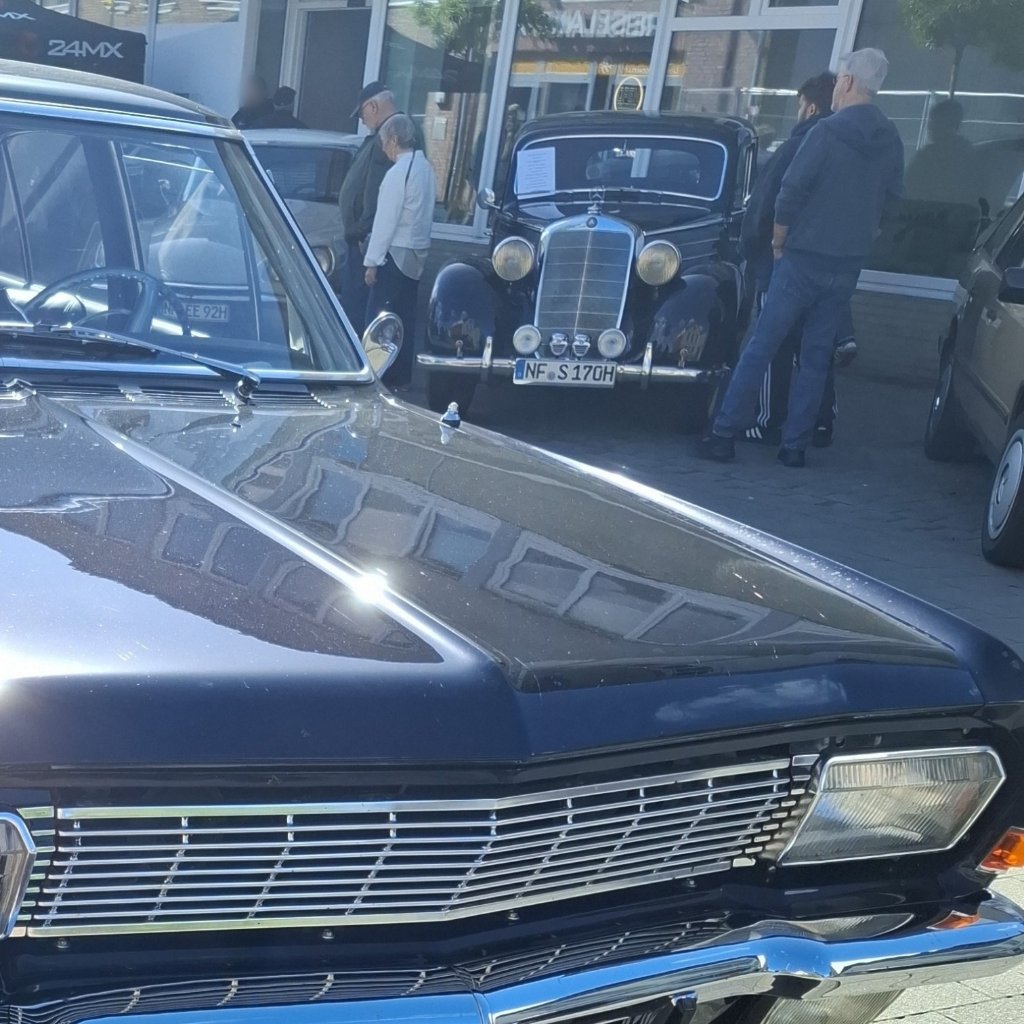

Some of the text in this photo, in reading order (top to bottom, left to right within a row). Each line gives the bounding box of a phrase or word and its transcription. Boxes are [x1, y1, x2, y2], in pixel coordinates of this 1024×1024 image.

[47, 39, 124, 58] 24MX
[203, 305, 227, 319] 92H
[525, 362, 615, 382] NF S 170H
